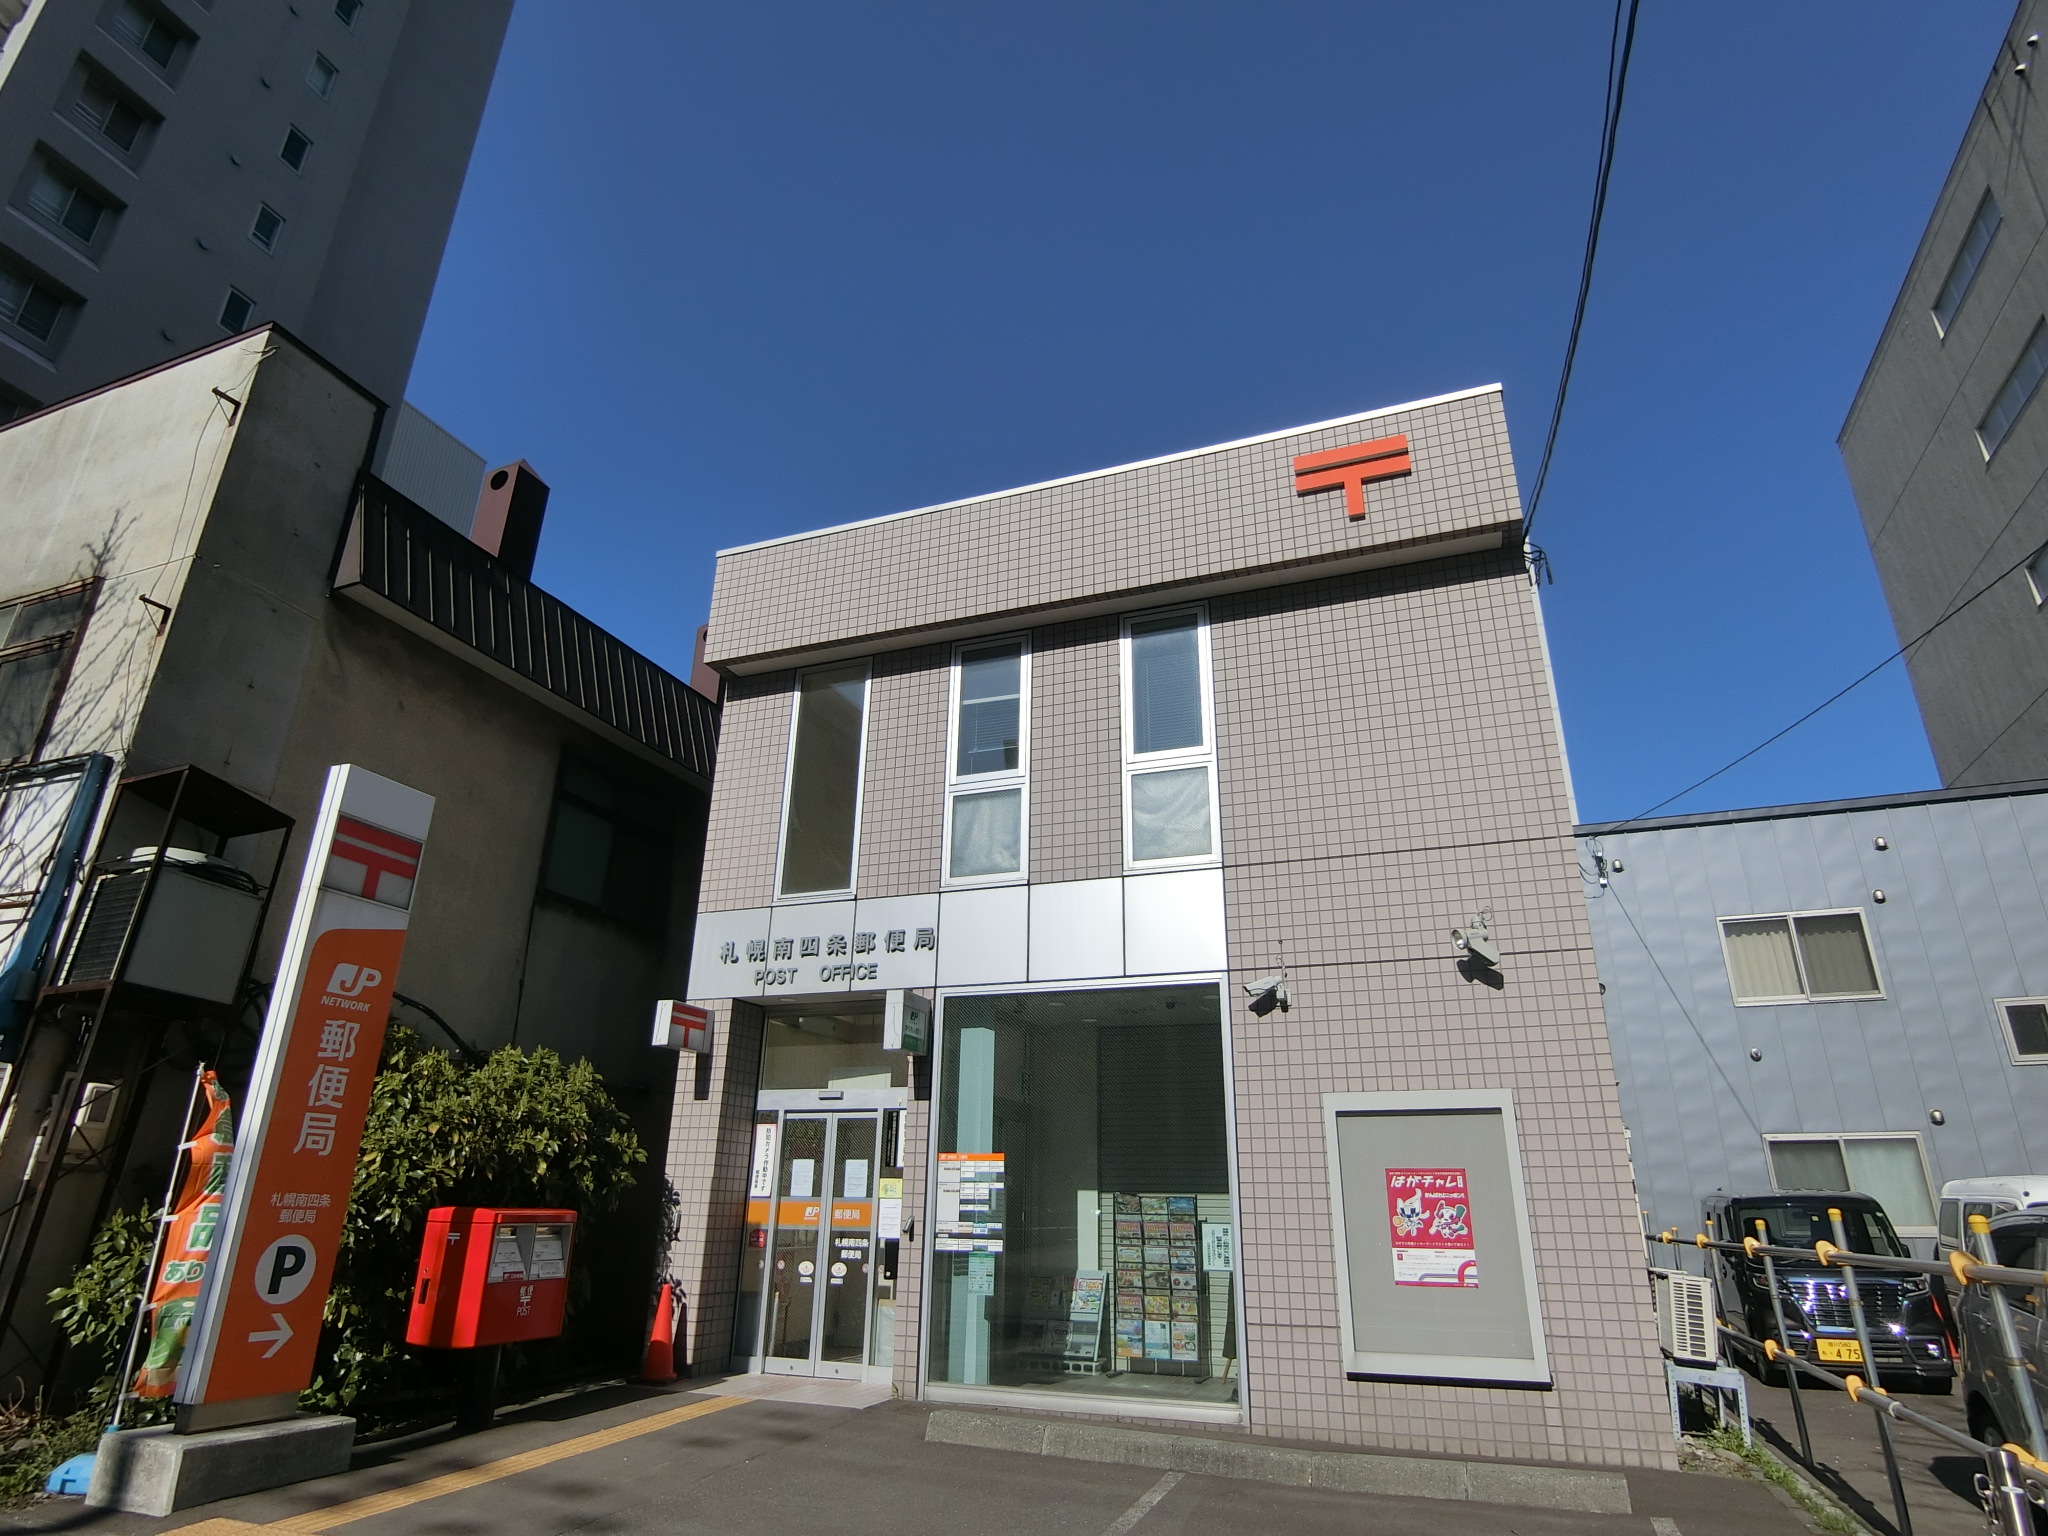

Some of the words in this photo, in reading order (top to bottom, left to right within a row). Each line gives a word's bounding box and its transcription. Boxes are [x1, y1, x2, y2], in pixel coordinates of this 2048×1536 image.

[719, 927, 936, 964] 札幌南四条郵便局
[326, 963, 382, 997] JP
[754, 966, 798, 985] POST
[819, 962, 879, 983] OFFICE
[321, 995, 371, 1012] NETWORK
[293, 1019, 361, 1156] 郵便局
[270, 1192, 331, 1208] 札幌南四条
[279, 1209, 317, 1224] 郵便局
[834, 1209, 861, 1220] 郵便局
[163, 1259, 206, 1283] あり
[267, 1245, 306, 1294] P
[516, 1306, 531, 1316] POST
